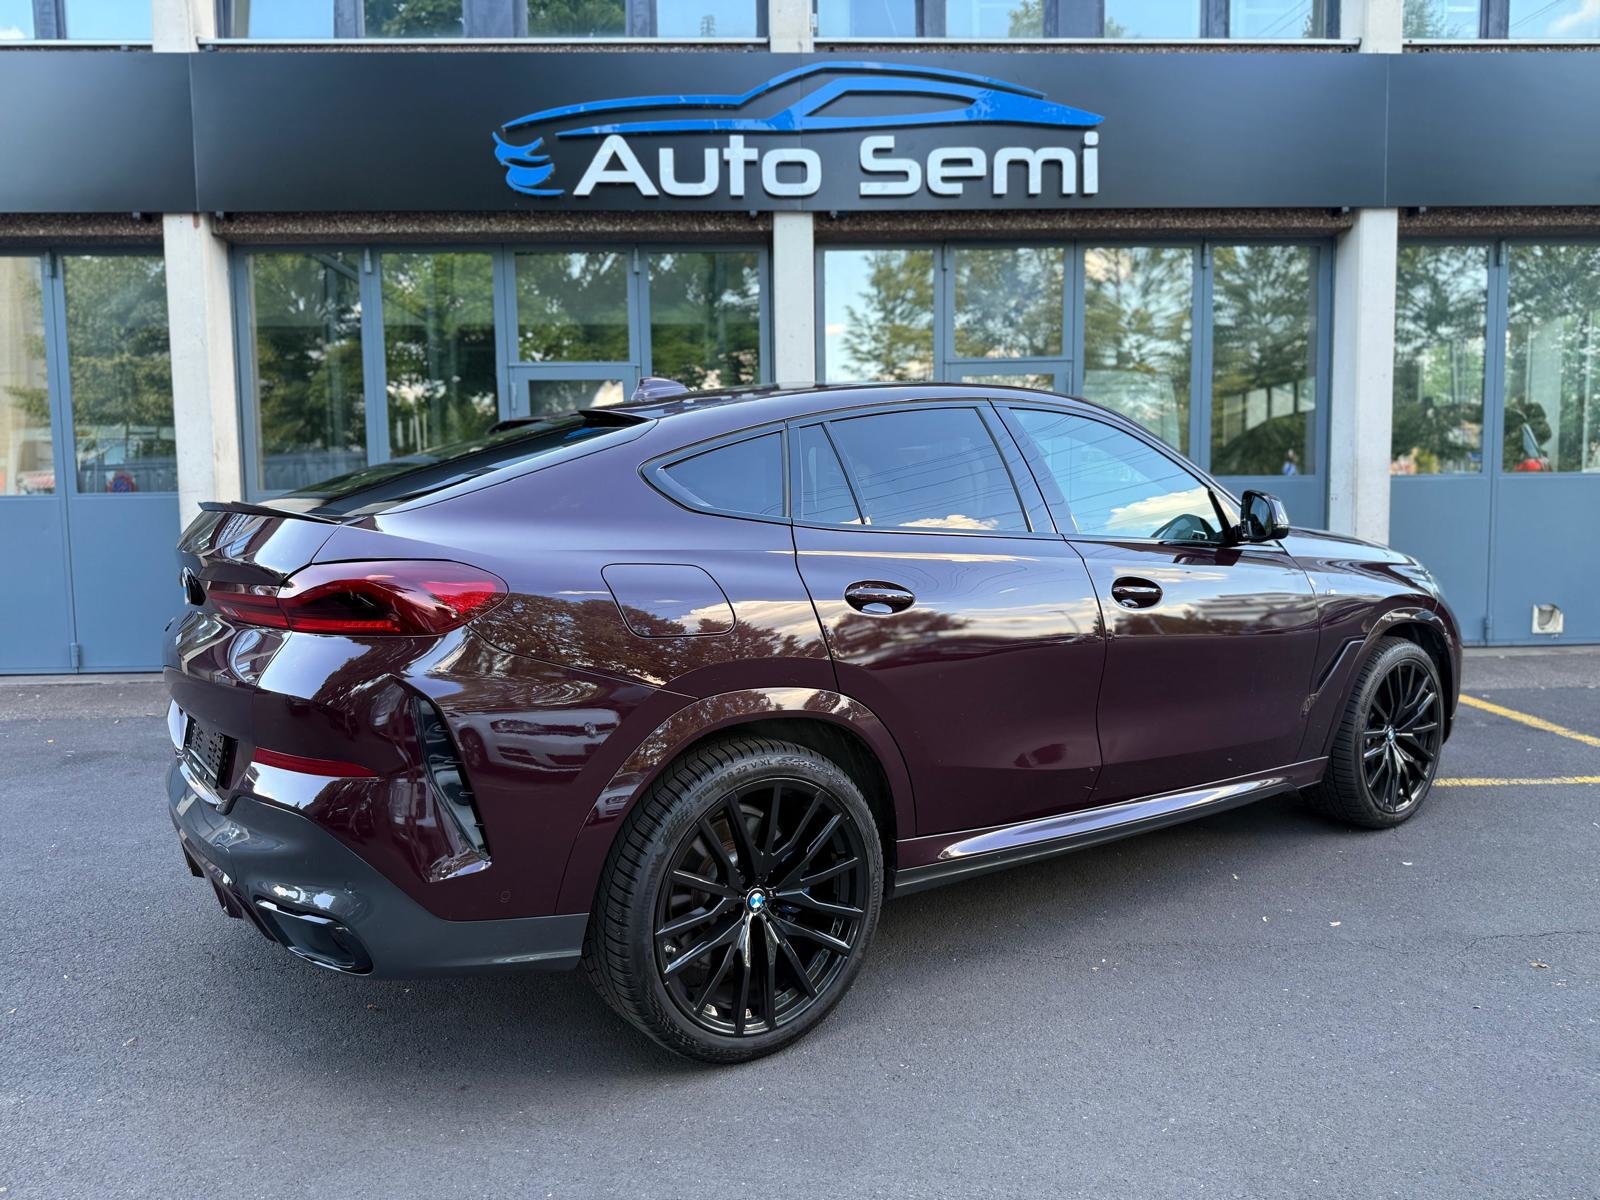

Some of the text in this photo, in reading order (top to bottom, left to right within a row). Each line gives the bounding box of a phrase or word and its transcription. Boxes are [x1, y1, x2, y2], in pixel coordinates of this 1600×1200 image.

[573, 131, 1099, 196] Auto Semi
[760, 758, 773, 767] XL
